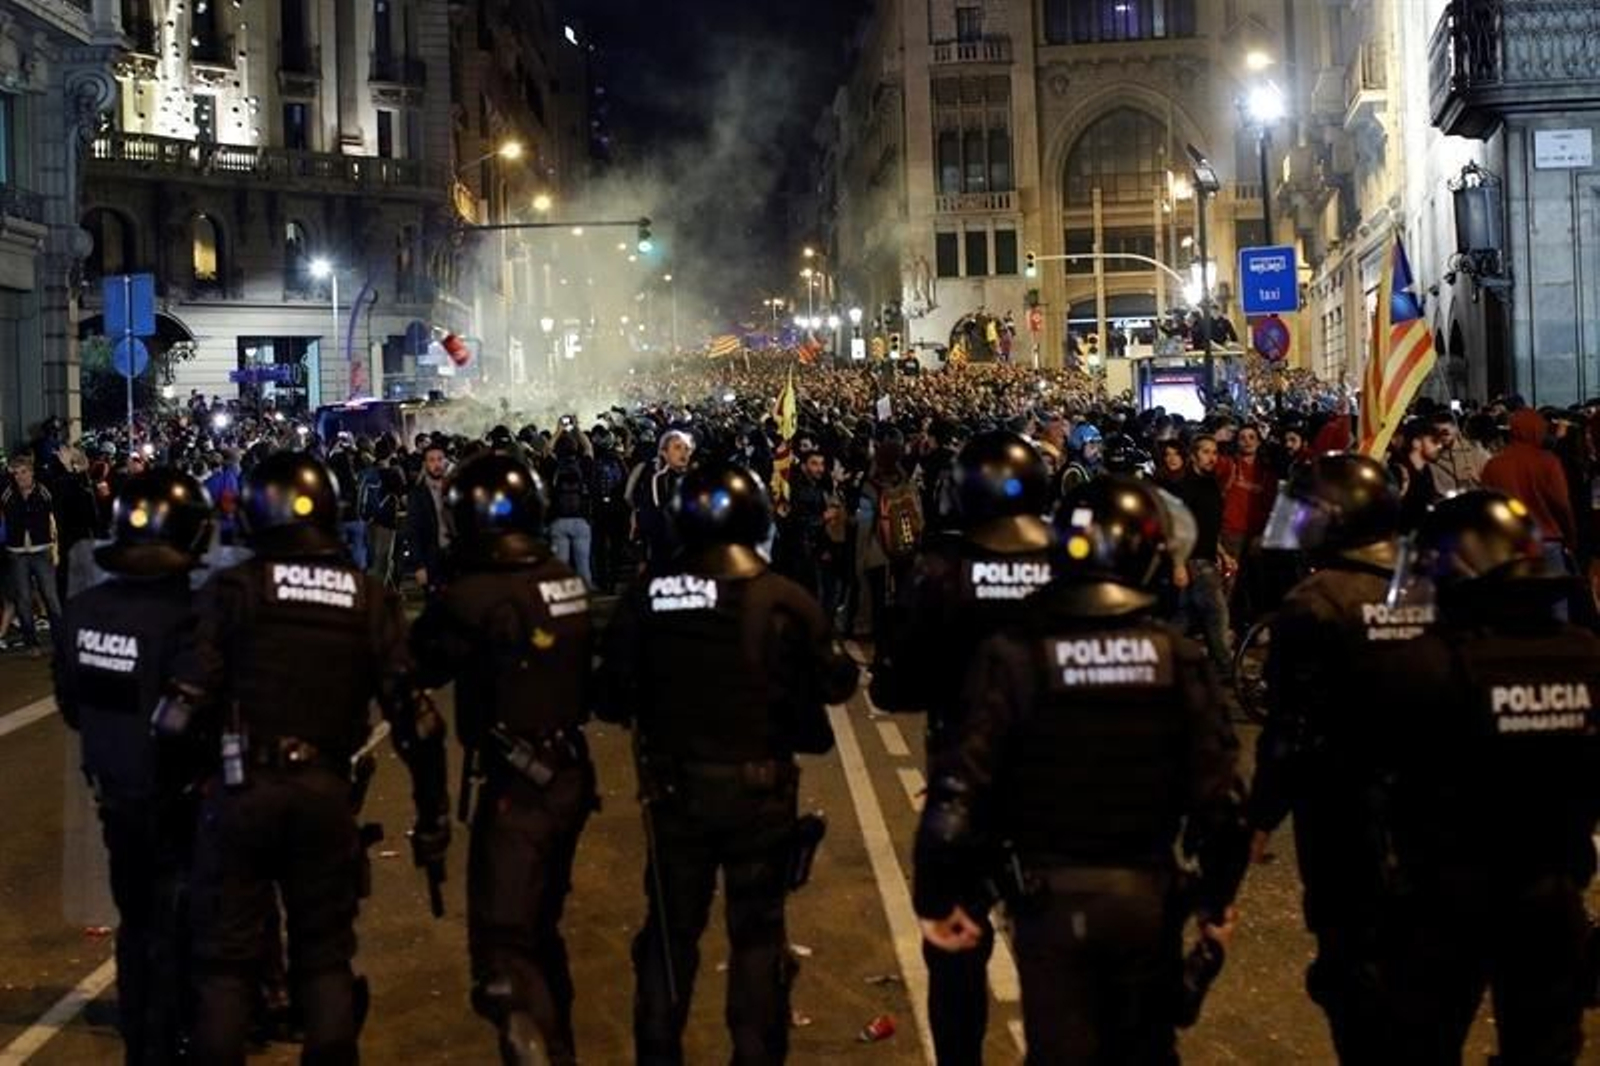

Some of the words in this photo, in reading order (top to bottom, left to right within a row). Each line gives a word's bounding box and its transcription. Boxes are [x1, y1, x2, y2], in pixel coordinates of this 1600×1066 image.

[1259, 287, 1280, 301] taxi
[273, 564, 356, 594] POLICIA
[77, 628, 138, 658] POLICIA
[1056, 638, 1158, 665] POLICIA
[1492, 683, 1591, 712] POLICIA
